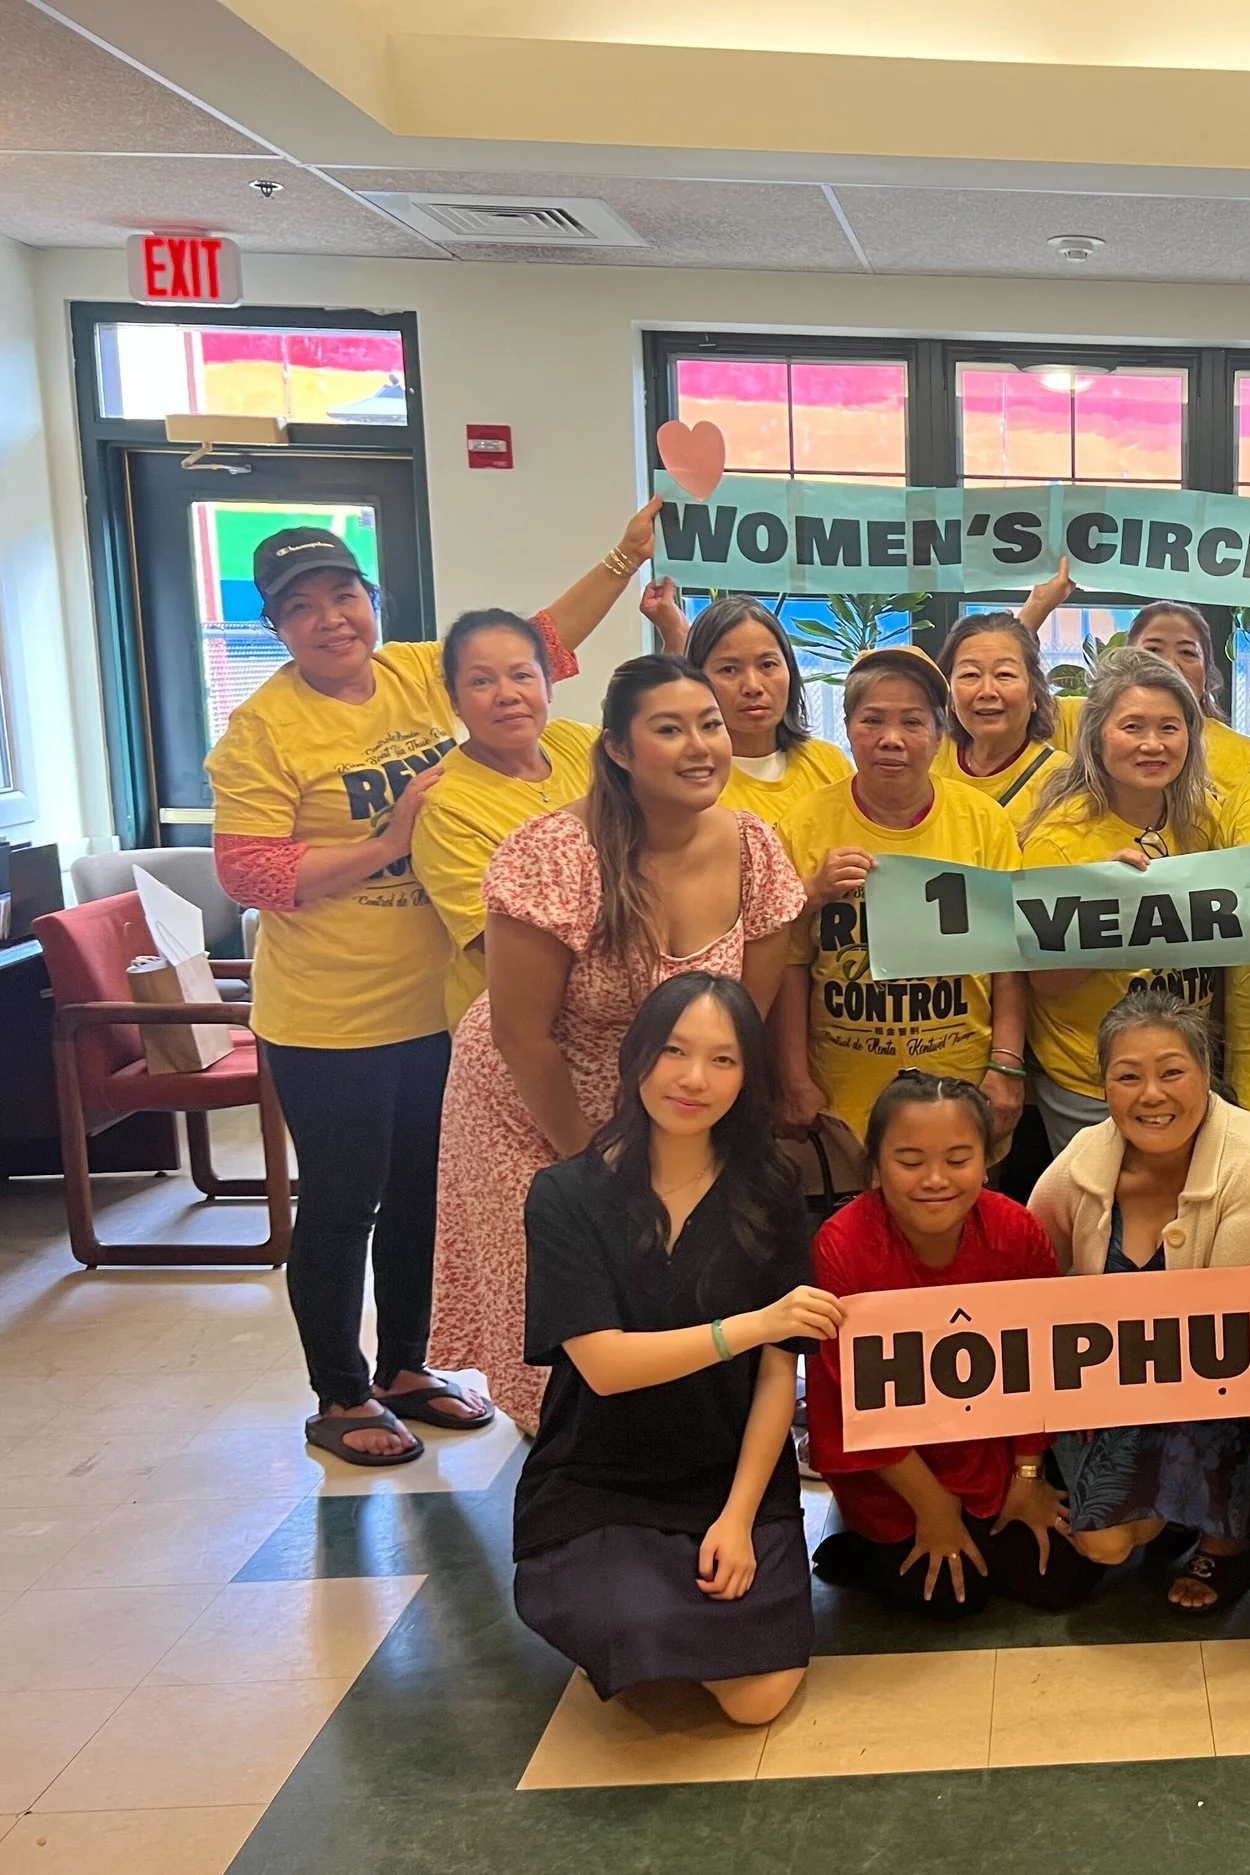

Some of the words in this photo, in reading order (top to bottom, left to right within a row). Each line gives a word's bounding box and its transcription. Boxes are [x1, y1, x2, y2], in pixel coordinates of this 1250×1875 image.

[144, 237, 222, 299] EXIT
[660, 501, 1043, 567] WOMEN'S
[925, 872, 970, 935] 1
[1016, 888, 1243, 952] YEAR
[824, 977, 968, 1022] CONTROL
[853, 1308, 1030, 1412] HỘI
[1052, 1311, 1250, 1395] PHỤ
